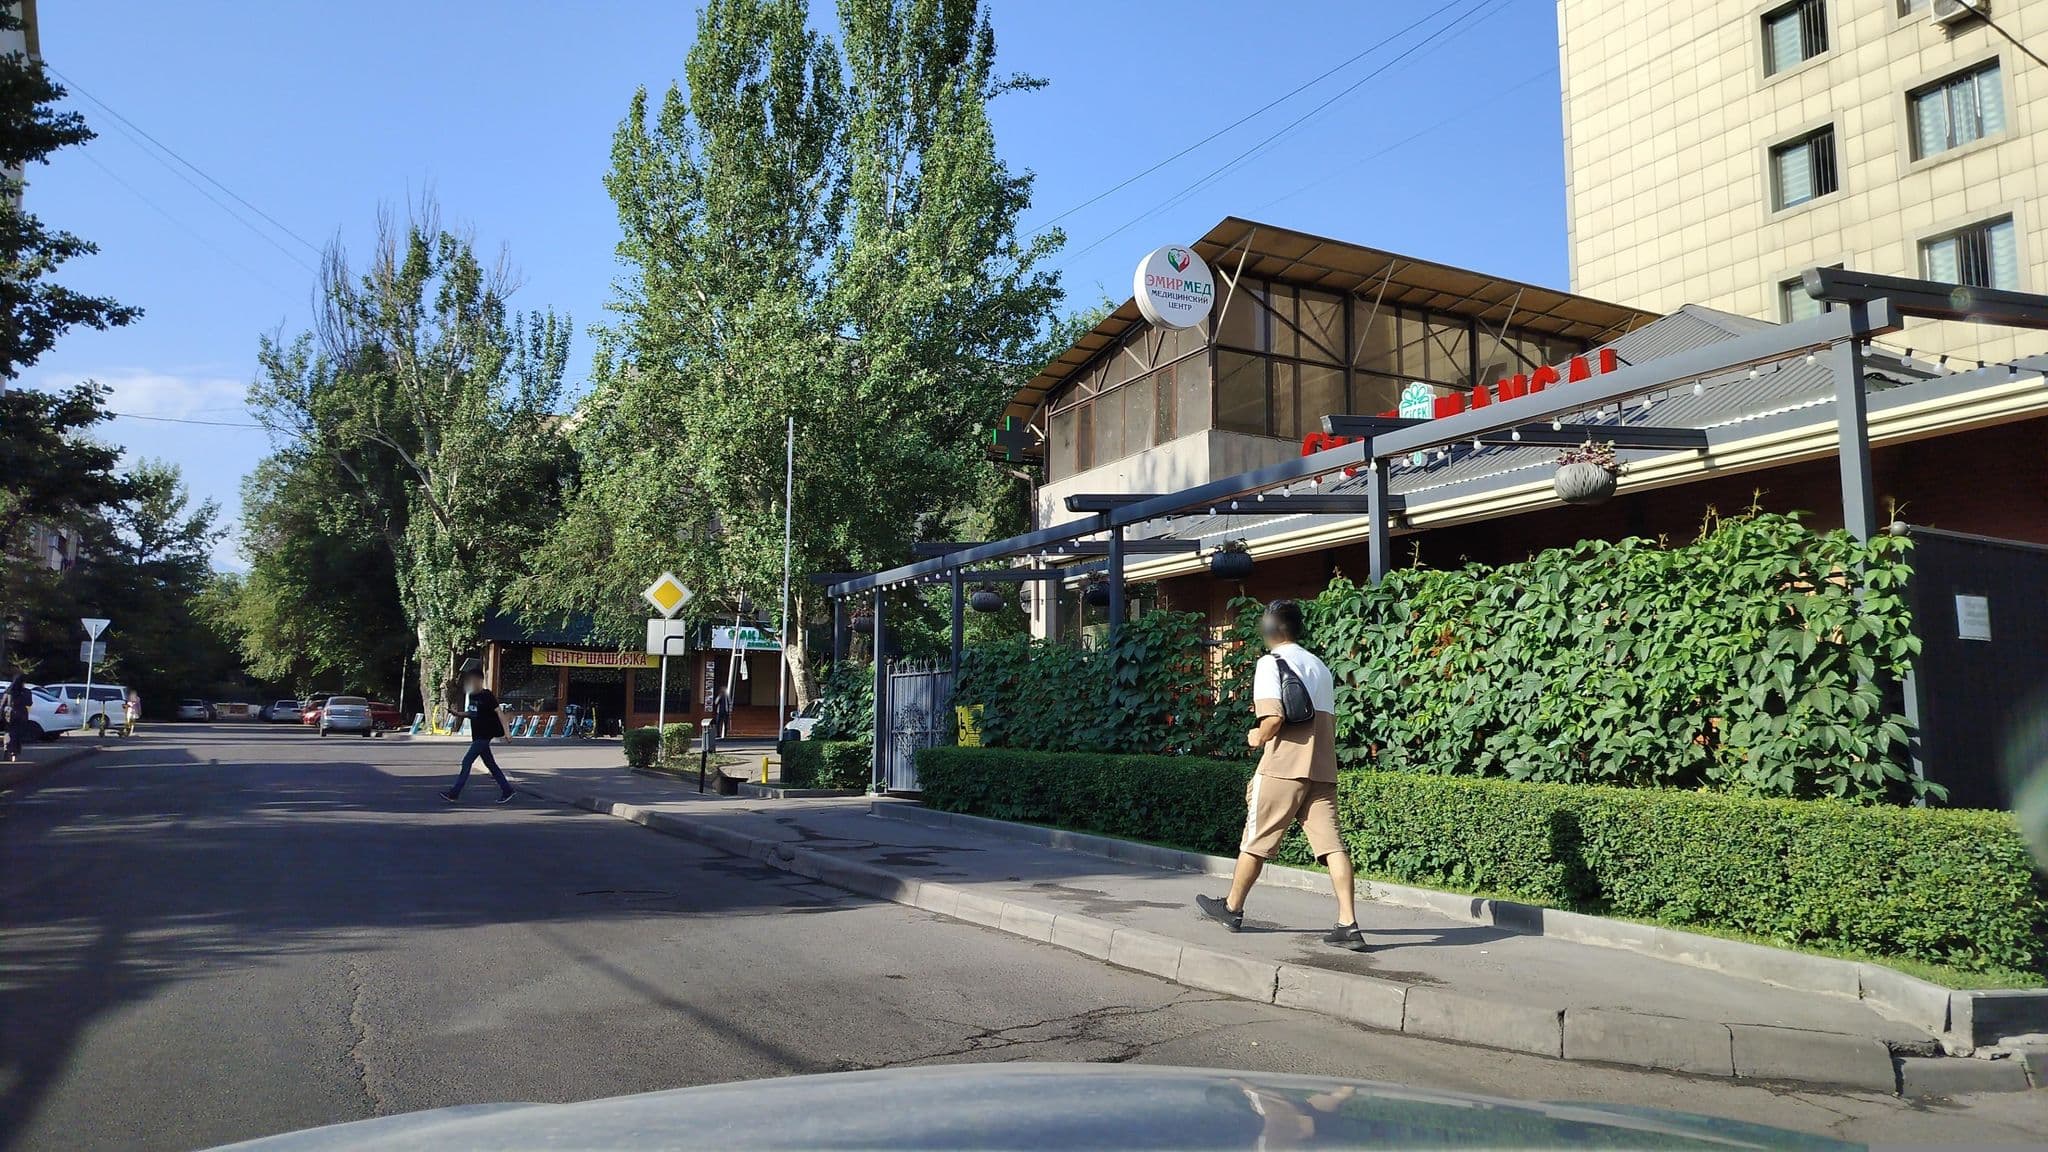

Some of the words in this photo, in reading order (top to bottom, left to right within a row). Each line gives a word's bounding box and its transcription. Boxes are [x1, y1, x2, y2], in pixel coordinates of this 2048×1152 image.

[1147, 275, 1211, 297] ЭМИРМЕД
[1152, 290, 1209, 305] МЕДИЦИНСКИЙ
[1168, 301, 1193, 311] ЦЕНТР
[546, 650, 583, 664] ЦЕНТР
[586, 652, 648, 665] ШАШЛЫКА
